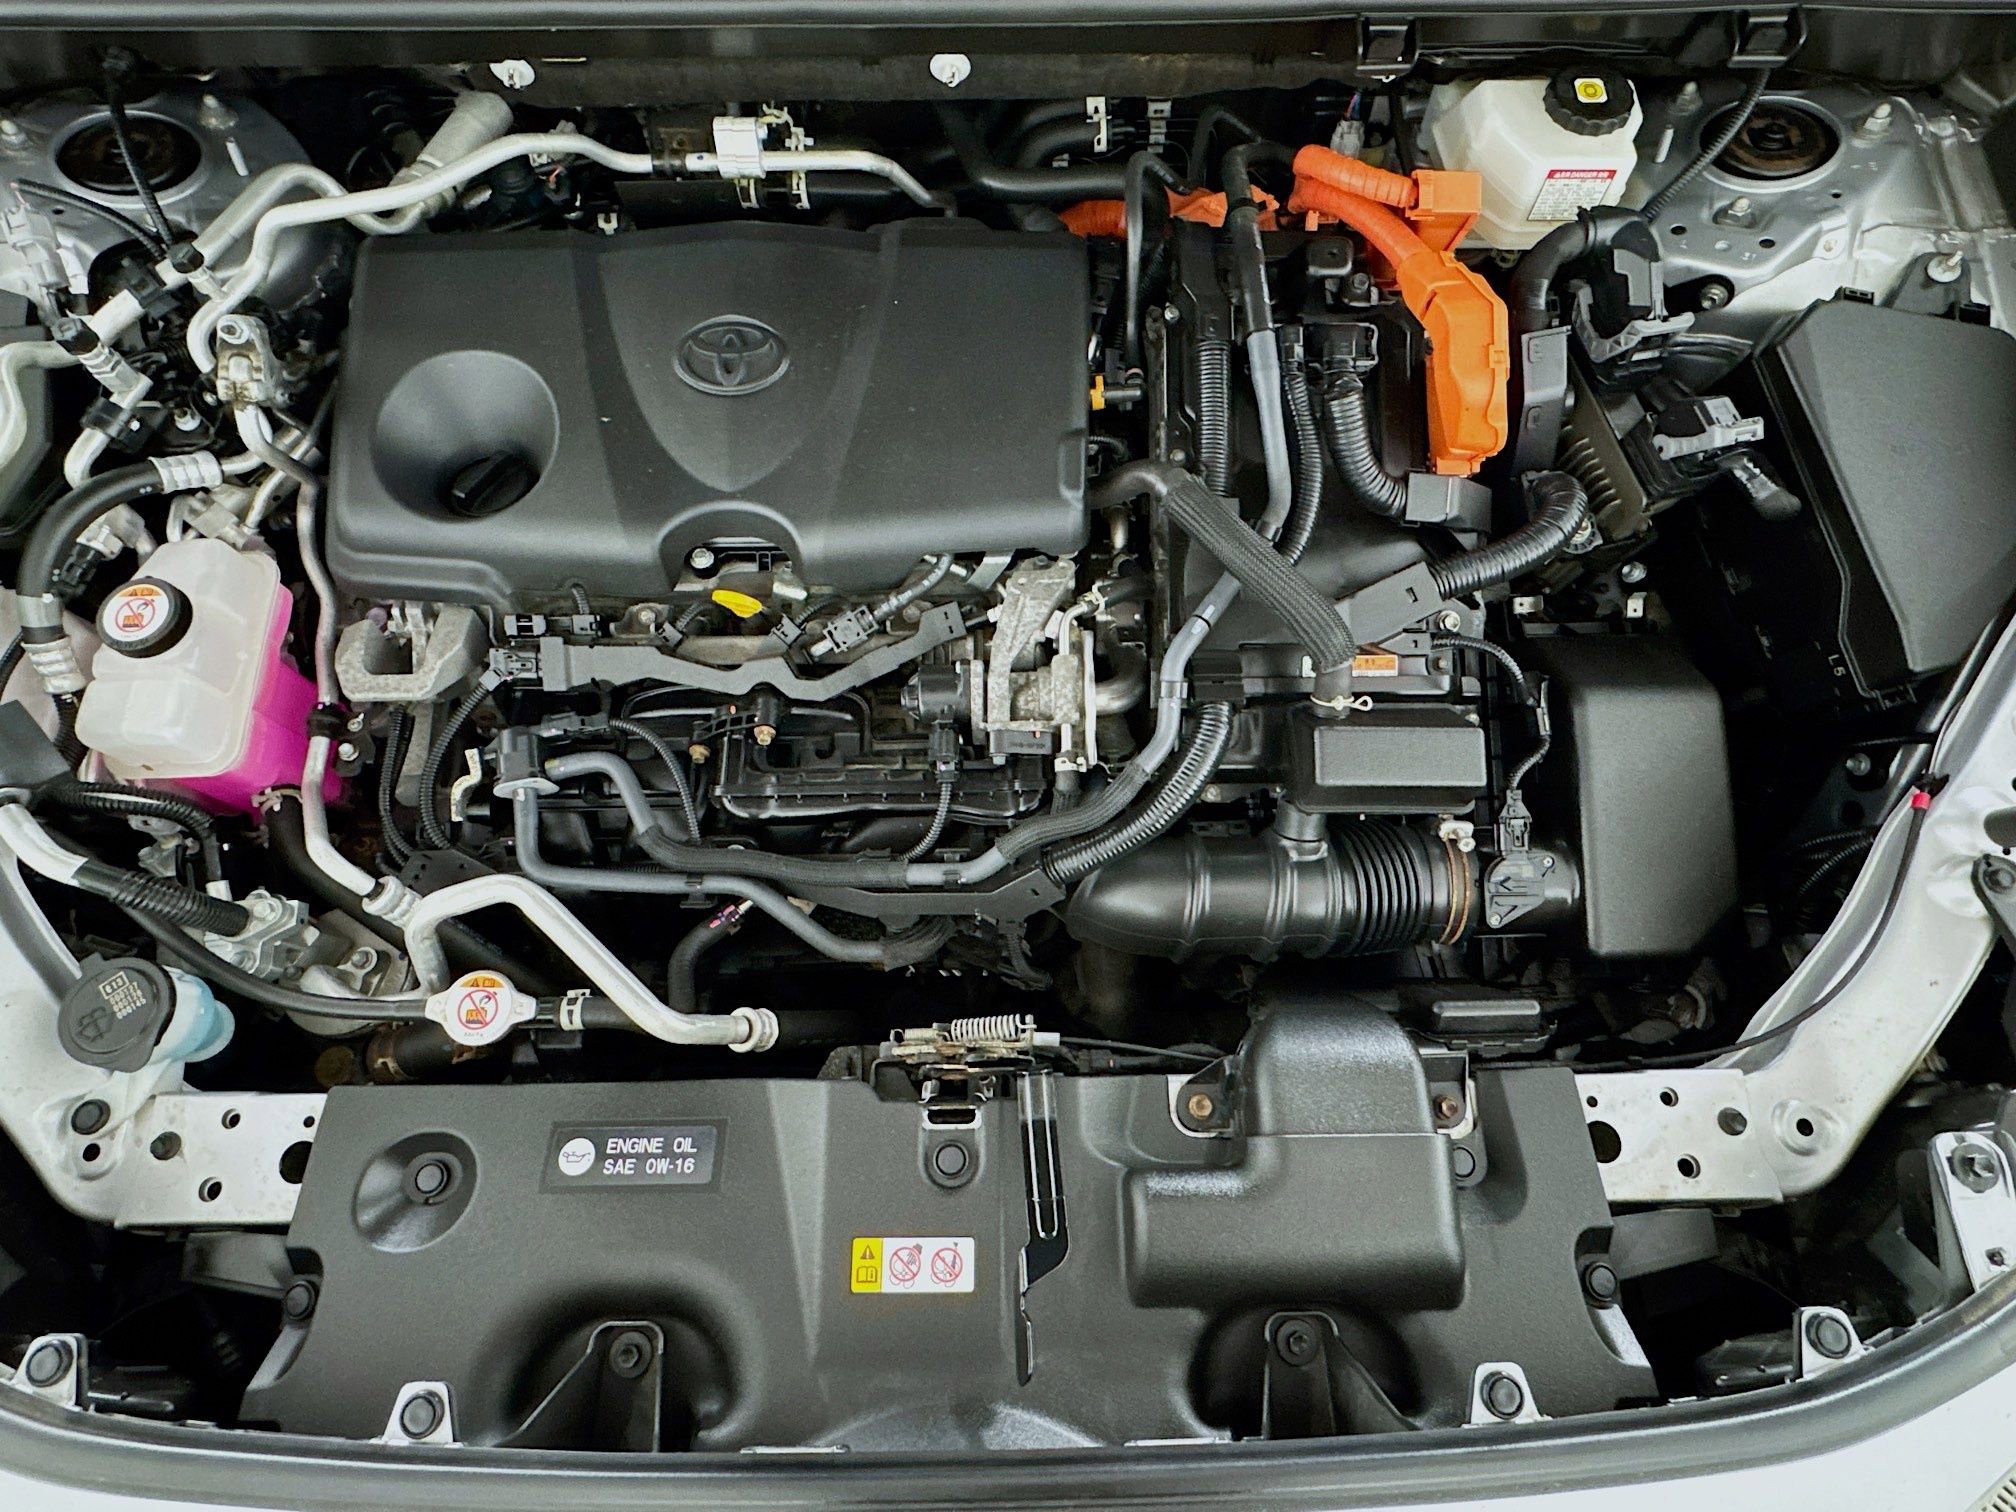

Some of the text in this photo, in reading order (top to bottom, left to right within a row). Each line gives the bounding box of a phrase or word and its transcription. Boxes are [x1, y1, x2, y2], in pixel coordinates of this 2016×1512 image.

[105, 977, 124, 994] e13
[605, 1136, 698, 1154] ENGINE OIL
[602, 1157, 696, 1175] SAE 0W-16
